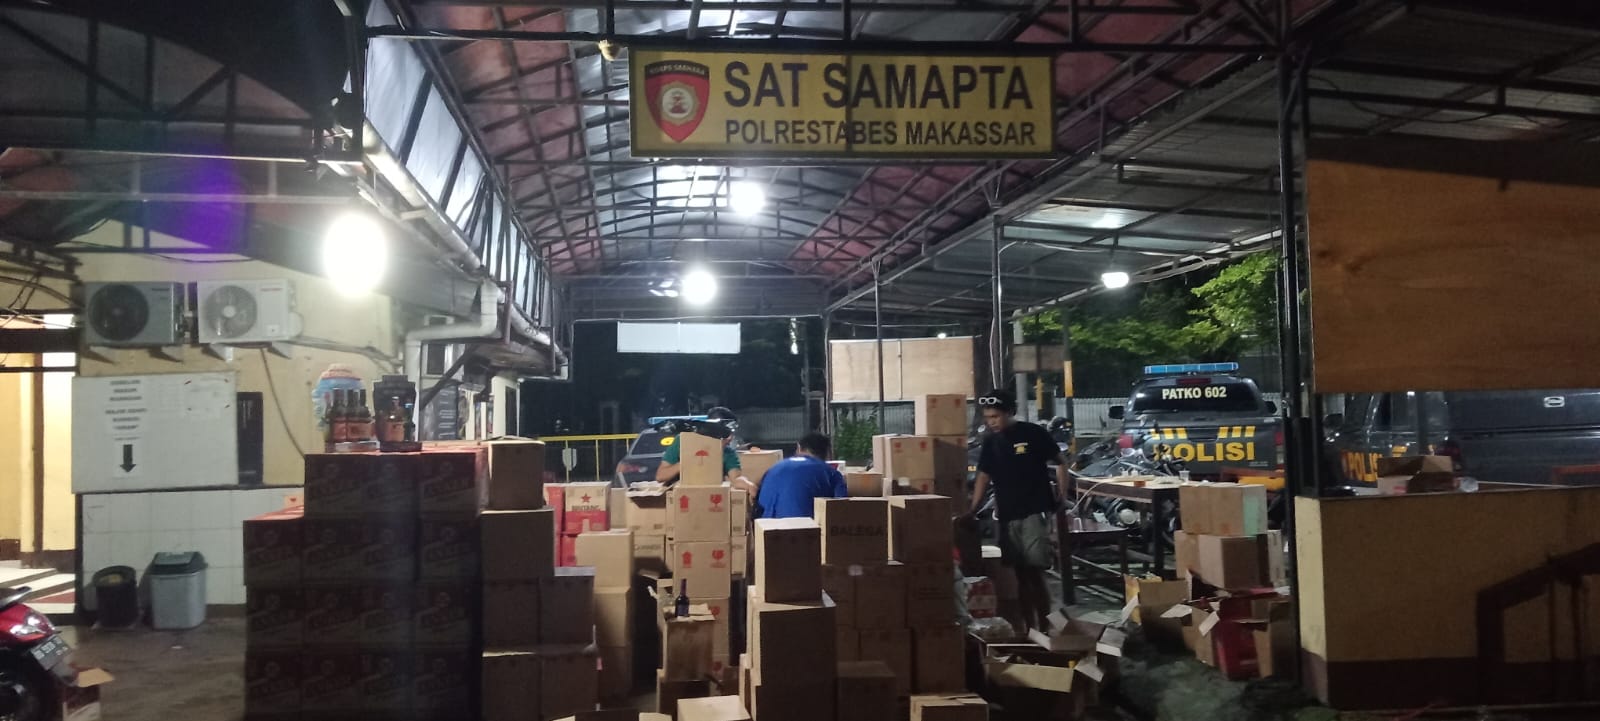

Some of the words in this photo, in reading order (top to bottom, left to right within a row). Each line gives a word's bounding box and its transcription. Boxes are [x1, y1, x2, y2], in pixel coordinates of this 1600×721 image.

[723, 61, 808, 108] SAT
[823, 62, 1034, 110] SAMAPTA
[725, 120, 898, 145] POLRESTABES
[905, 121, 1036, 146] MAKASSAR
[1162, 387, 1202, 400] PATKO
[1204, 386, 1228, 398] 602
[1152, 442, 1255, 462] POLISI
